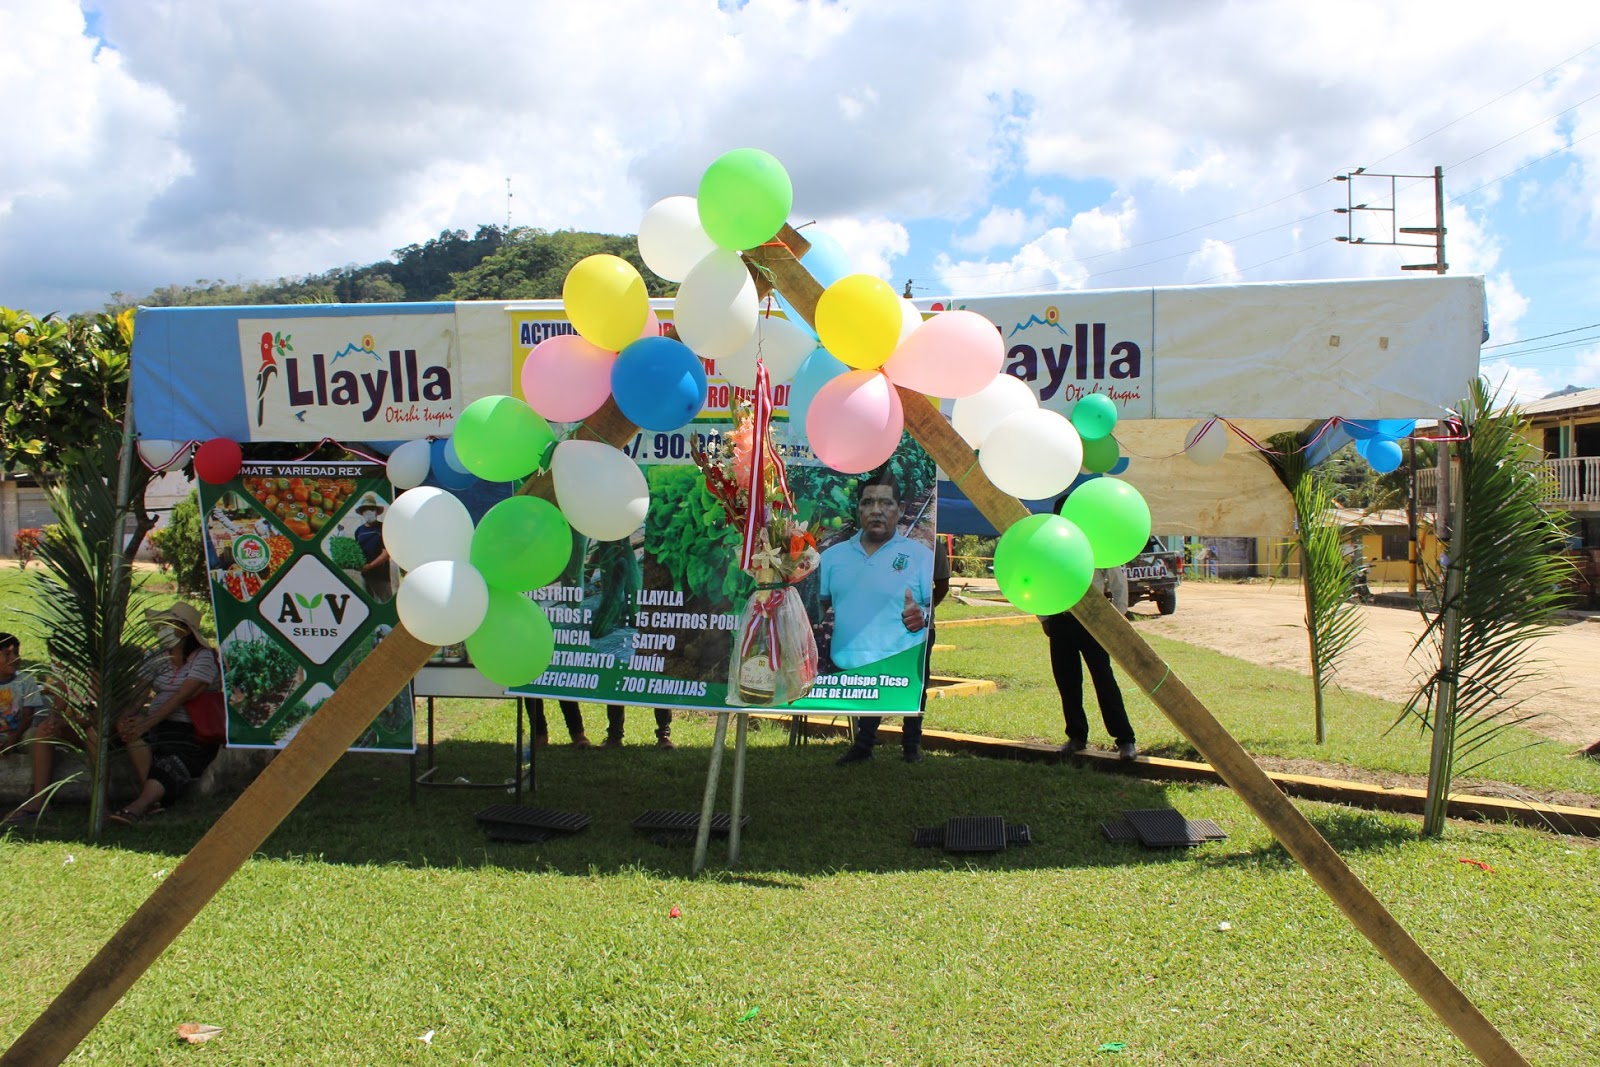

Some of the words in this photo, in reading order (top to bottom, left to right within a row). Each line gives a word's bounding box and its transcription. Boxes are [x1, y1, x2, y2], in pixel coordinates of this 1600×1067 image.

[996, 323, 1141, 401] aylla
[286, 350, 452, 422] Llaylla
[385, 404, 420, 422] Otishi
[238, 466, 273, 475] MATE
[277, 466, 336, 476] VARIEDAD
[338, 467, 362, 476] REX
[1121, 565, 1168, 579] LAYLLA
[636, 590, 683, 607] LLAYLLA
[583, 609, 592, 624] P.
[635, 611, 649, 628] 15
[651, 612, 708, 629] CENTROS
[293, 627, 338, 637] SEEDS
[632, 633, 676, 651] SATIPO
[549, 650, 615, 669] RTAMENTO
[628, 653, 665, 672] JUNÍN
[647, 678, 707, 697] FAMILIAS
[840, 674, 877, 687] Quispe
[879, 675, 909, 687] Ticse
[829, 688, 840, 698] DE
[842, 688, 879, 699] LLAYLLA
